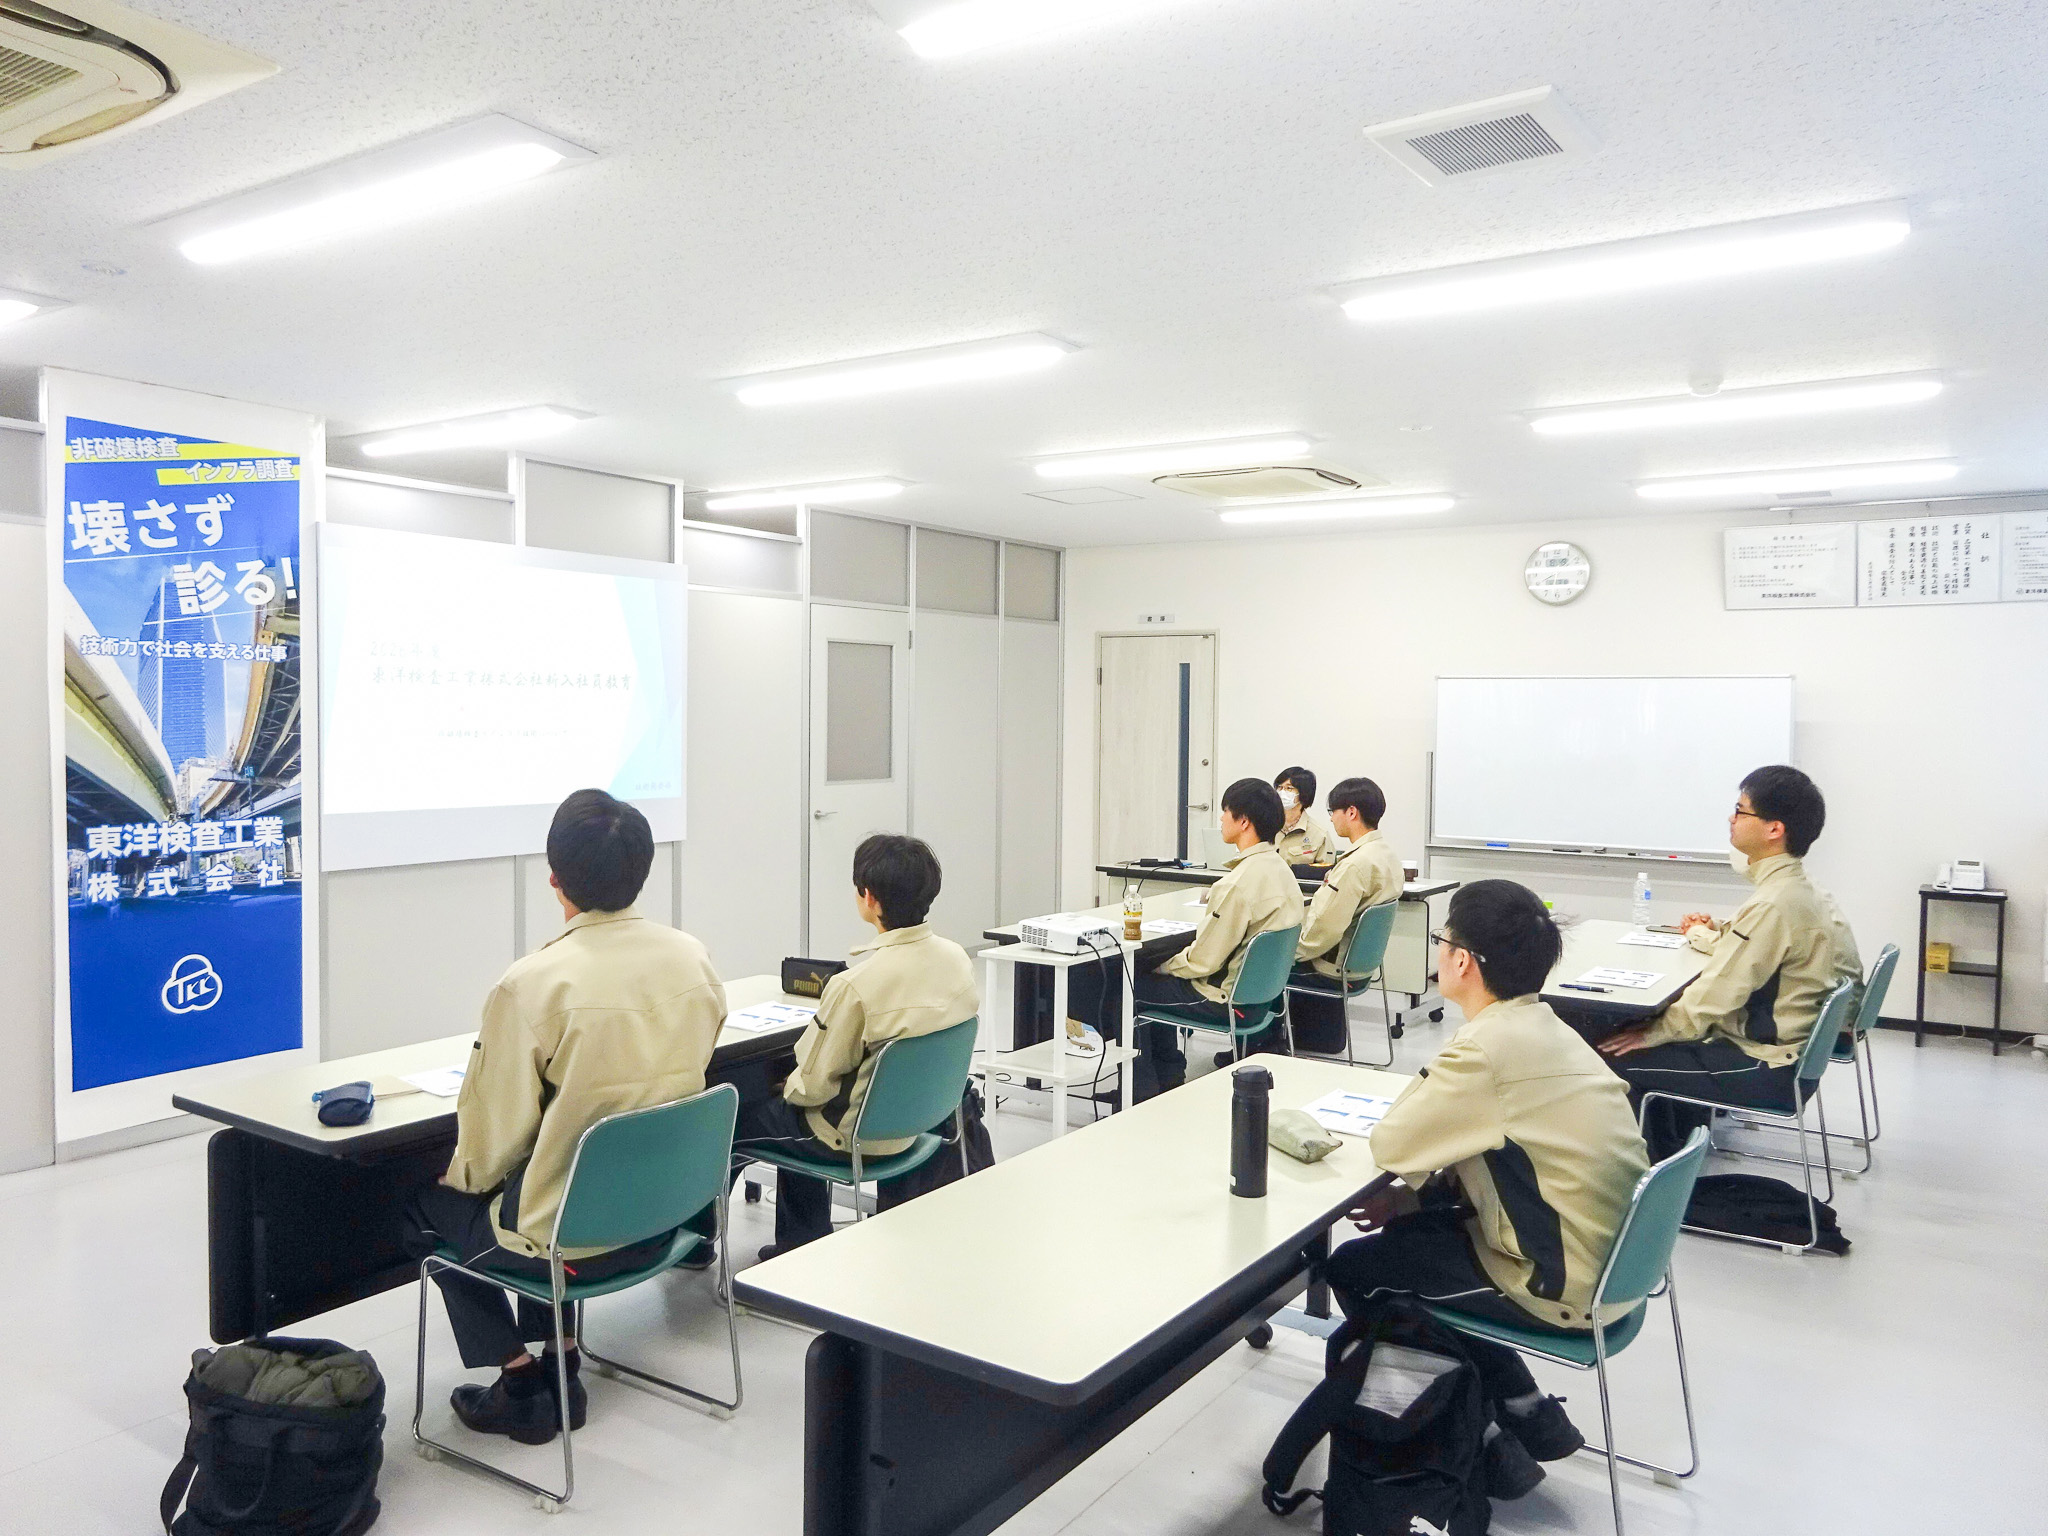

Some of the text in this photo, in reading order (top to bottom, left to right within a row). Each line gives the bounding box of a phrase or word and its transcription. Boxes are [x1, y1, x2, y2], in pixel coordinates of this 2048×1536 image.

[70, 437, 179, 460] 非破壊検査
[184, 459, 295, 481] インフラ調査
[68, 493, 235, 556] 壊さず
[173, 557, 298, 615] 診る!
[80, 636, 288, 662] 技術力で社会を支える仕事
[86, 815, 285, 860] 東洋検査工業
[87, 859, 285, 903] 株式会社
